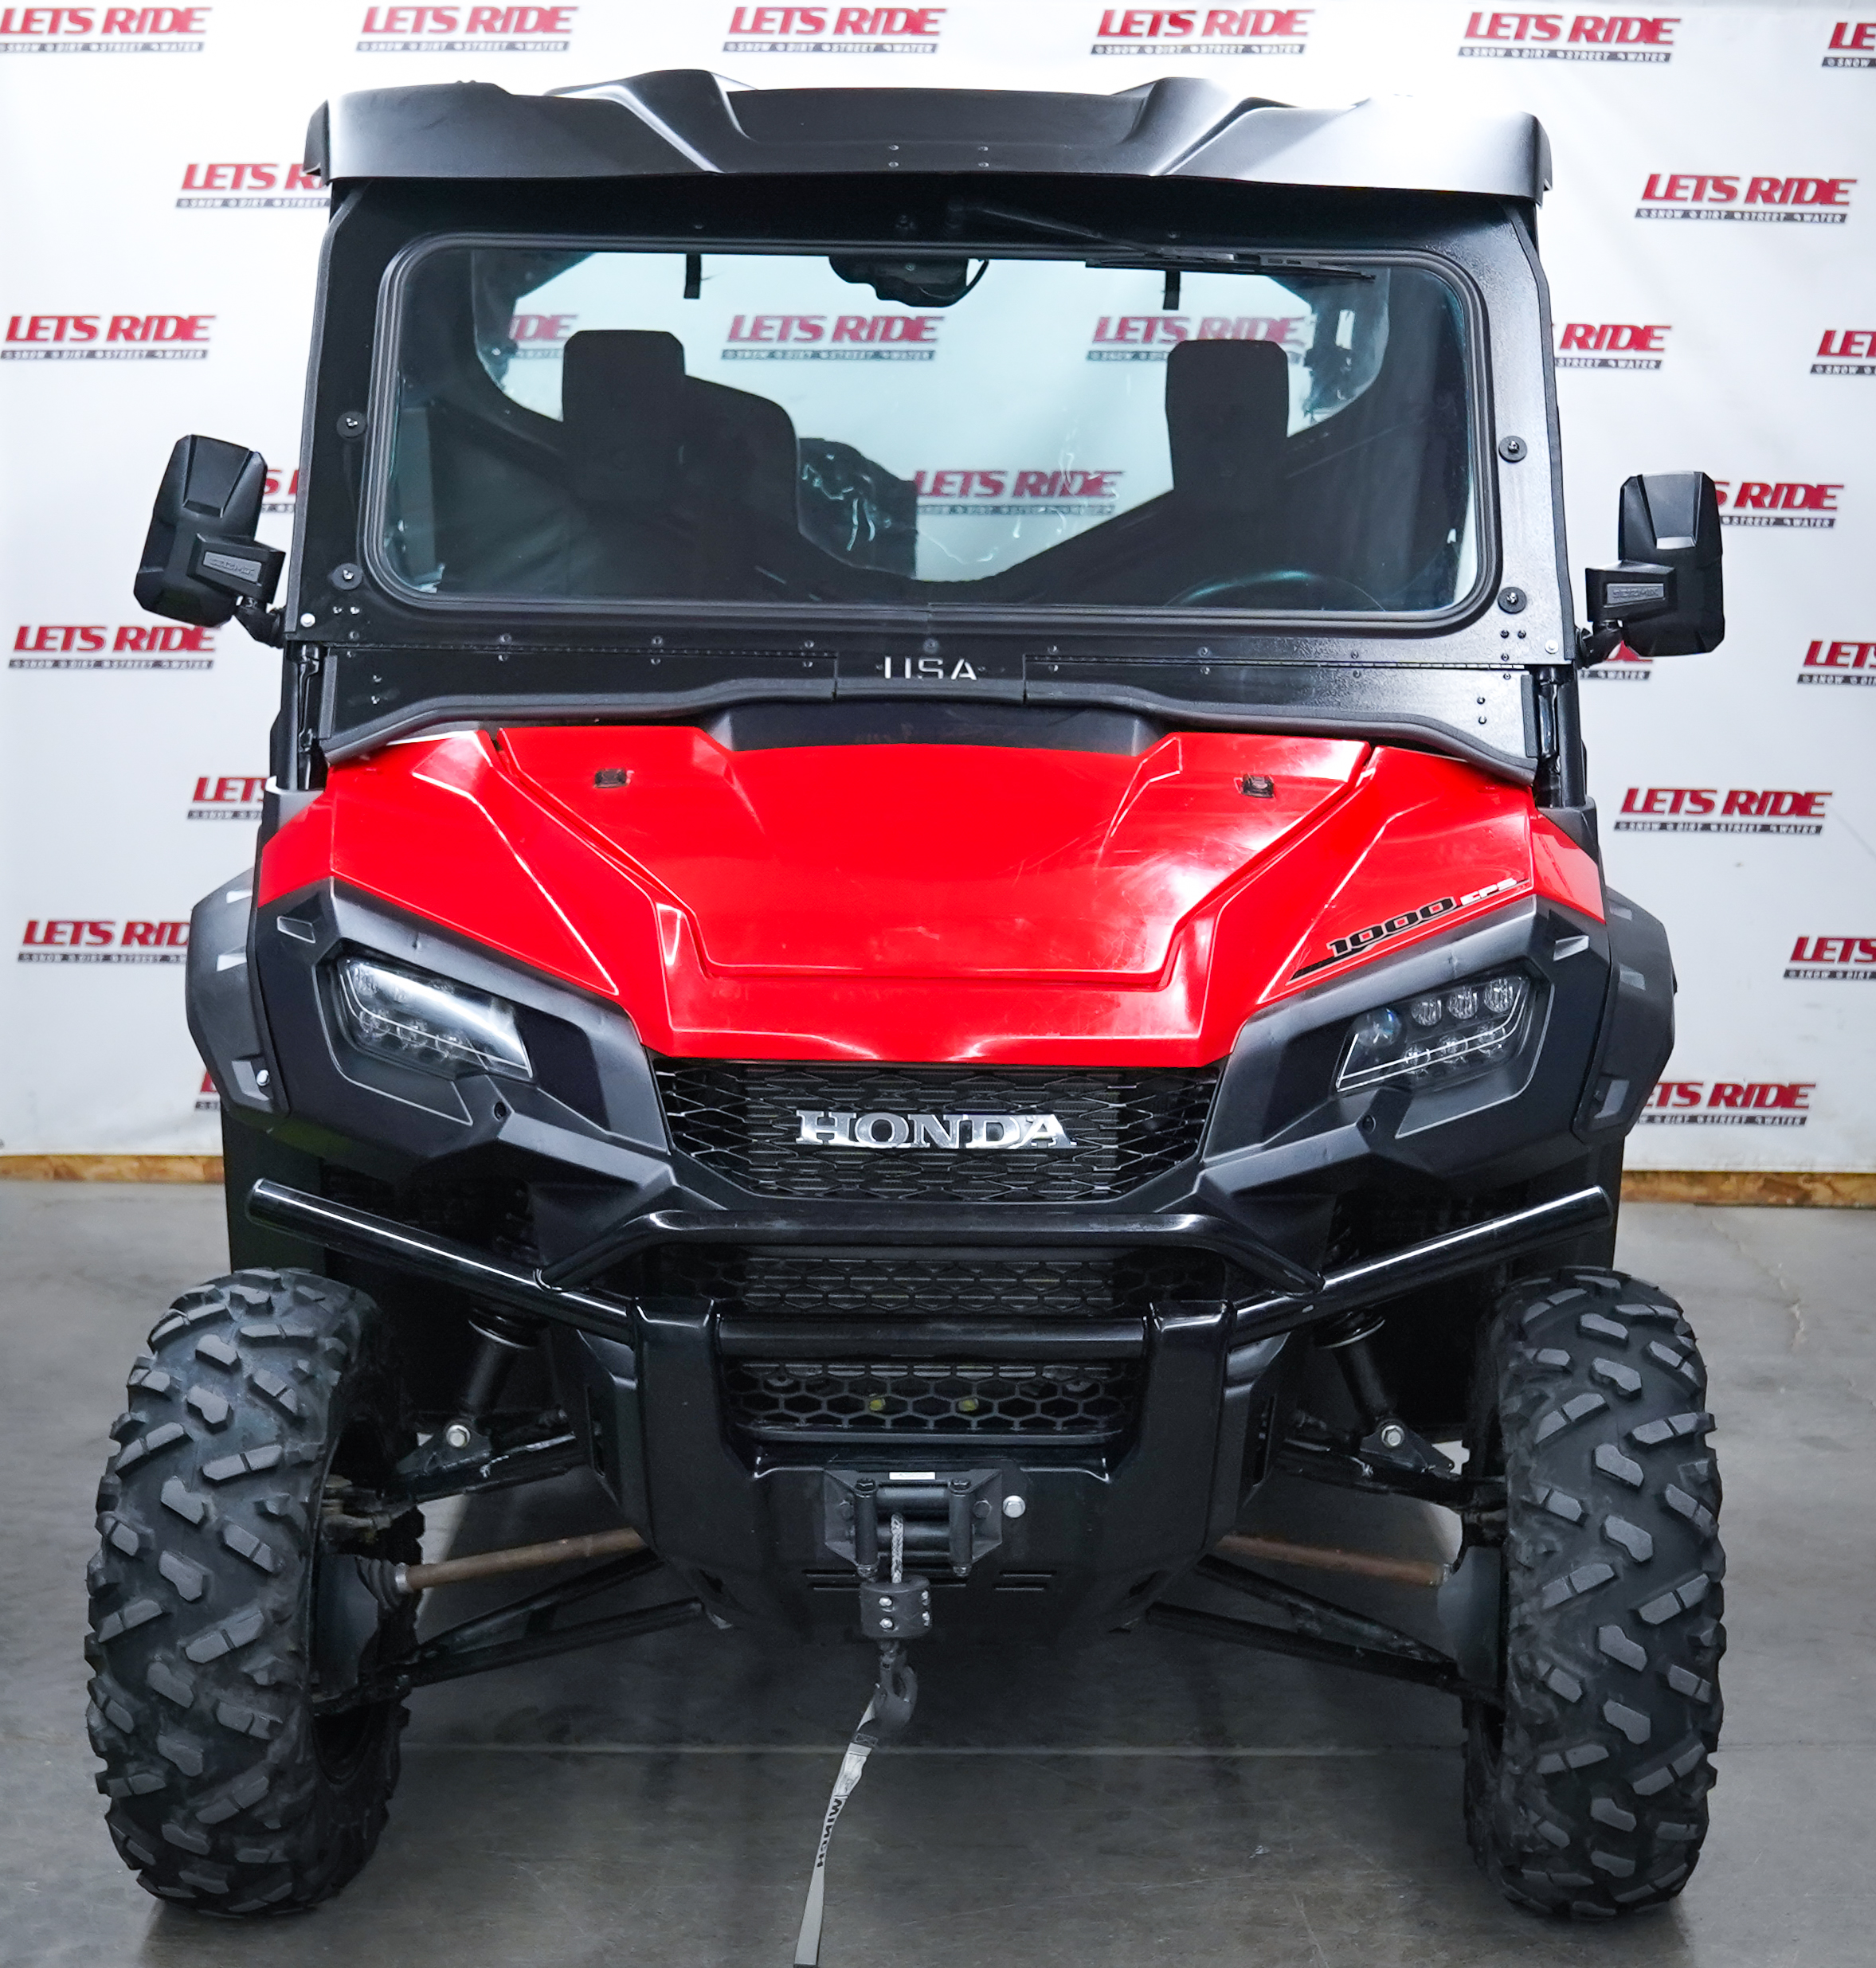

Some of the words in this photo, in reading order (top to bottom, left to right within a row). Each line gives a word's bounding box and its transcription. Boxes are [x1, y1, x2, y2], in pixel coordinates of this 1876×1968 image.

[0, 7, 94, 34] LETS
[101, 7, 211, 34] RIDE
[362, 6, 460, 33] LETS
[466, 6, 578, 33] RIDE
[728, 7, 828, 34] LETS
[833, 7, 947, 35] RIDE
[1097, 10, 1197, 37] LETS
[1202, 10, 1314, 37] RIDE
[1464, 12, 1563, 41] LETS
[1568, 15, 1681, 45] RIDE
[1828, 22, 1876, 50] LE
[1472, 49, 1506, 58] SNOW
[1522, 49, 1551, 59] DIRT
[1565, 51, 1611, 60] STREET
[1628, 53, 1669, 61] WATER
[181, 163, 279, 190] LETS
[1641, 174, 1740, 202] LETS
[1745, 177, 1857, 205] RIDE
[5, 315, 101, 342] LETS
[106, 315, 215, 342] RIDE
[727, 315, 827, 342] LETS
[832, 315, 945, 342] RIDE
[1092, 316, 1189, 343] LETS
[1196, 317, 1306, 343] RIDE
[1559, 323, 1671, 351] RIDE
[1816, 330, 1876, 357] LET
[915, 470, 1008, 498] LETS
[1012, 470, 1124, 498] RIDE
[1733, 482, 1844, 510] RIDE
[1729, 517, 1775, 526] STREET
[1792, 518, 1832, 527] WATER
[13, 625, 107, 651] LETS
[113, 625, 222, 651] RIDE
[884, 657, 977, 680] USA
[1619, 787, 1718, 815] LETS
[1721, 788, 1833, 818] RIDE
[1326, 897, 1457, 957] 1000
[1460, 878, 1517, 906] EPS
[22, 920, 116, 947] LETS
[121, 921, 190, 947] RID
[1646, 1082, 1703, 1108] TS
[1707, 1082, 1816, 1109] RIDE
[797, 1110, 1076, 1148] HONDA
